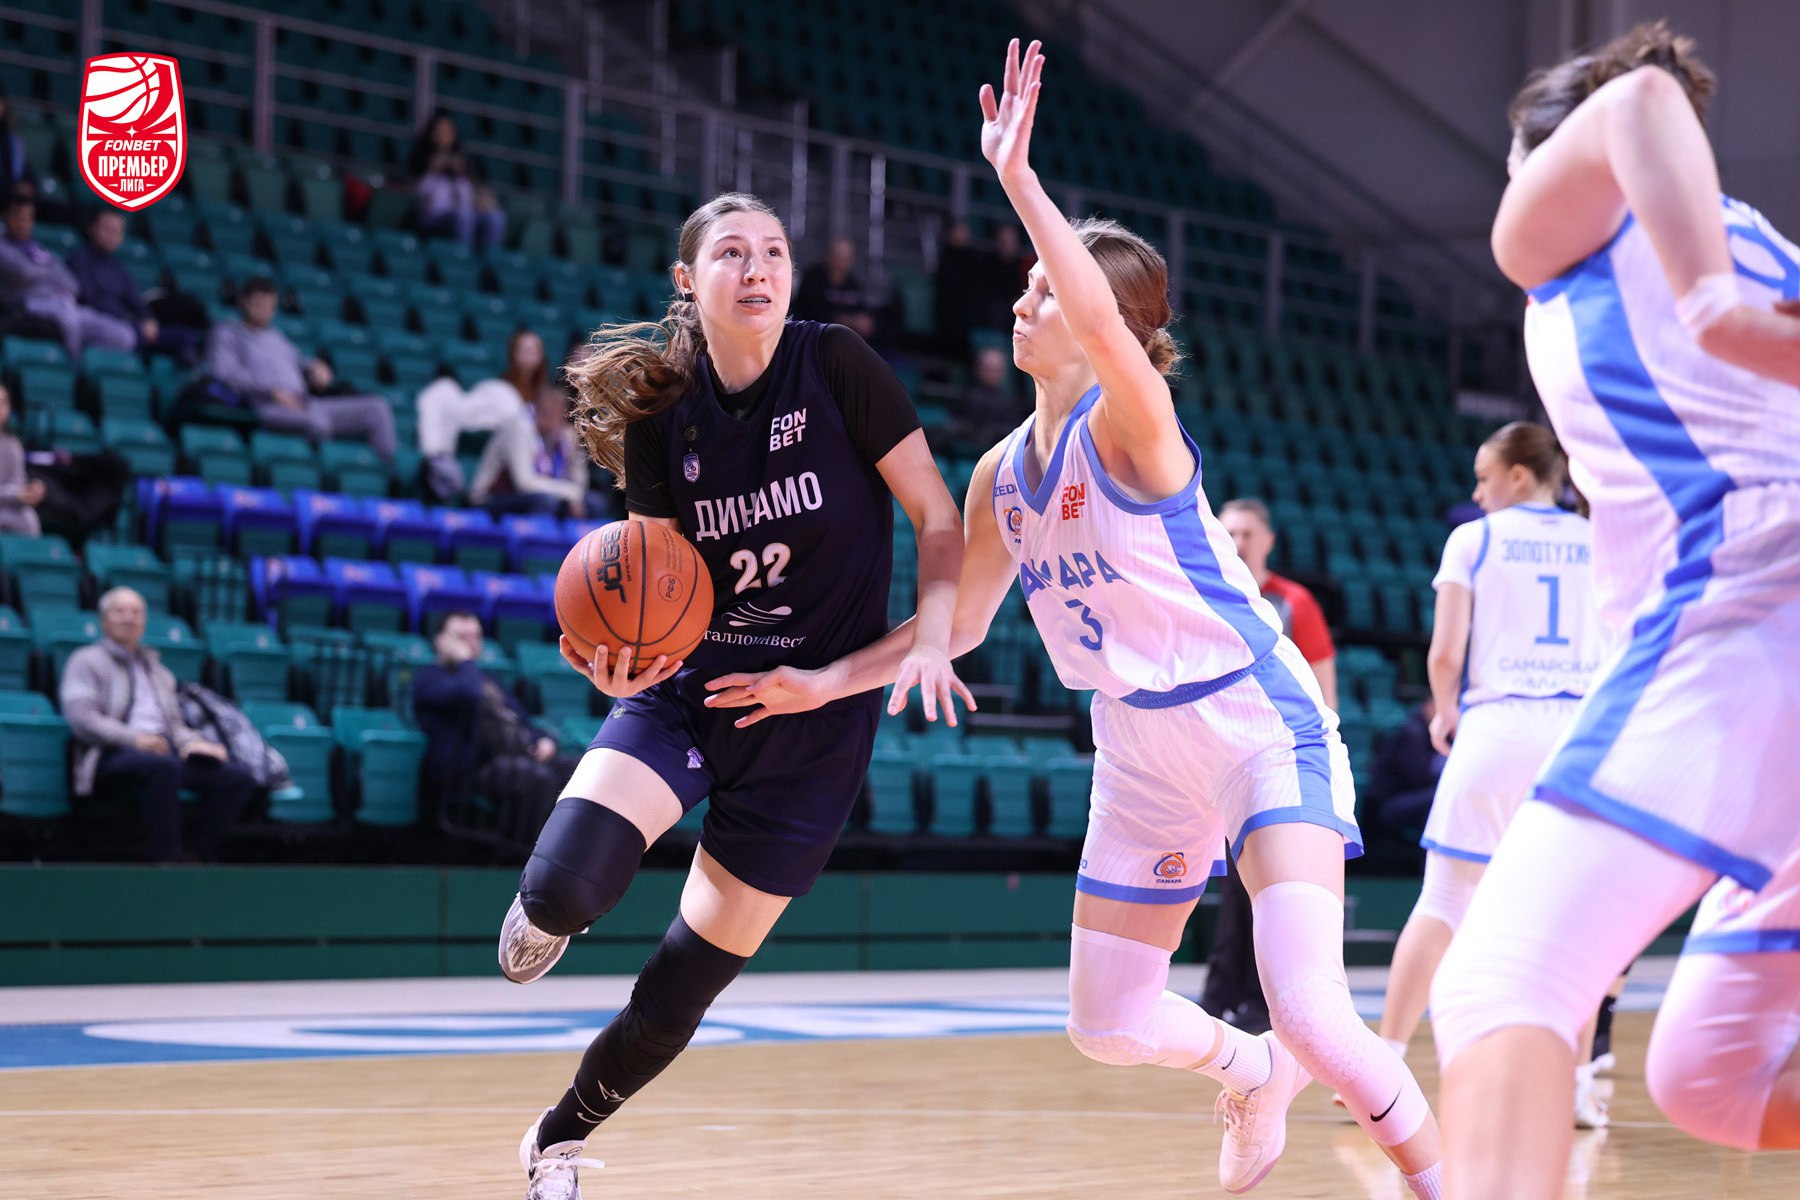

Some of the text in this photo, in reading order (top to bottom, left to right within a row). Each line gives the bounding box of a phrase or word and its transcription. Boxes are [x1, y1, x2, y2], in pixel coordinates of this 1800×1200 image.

[770, 407, 807, 435] FON
[769, 424, 806, 452] BET
[694, 471, 823, 542] ДИНАМО
[1062, 482, 1085, 503] FON
[1062, 501, 1085, 520] BET
[729, 542, 791, 595] 22
[1020, 550, 1132, 602] АМАРА
[665, 577, 676, 598] РФБ
[1535, 575, 1569, 645] 1
[703, 629, 807, 648] таллоинвест
[1064, 598, 1103, 651] 3
